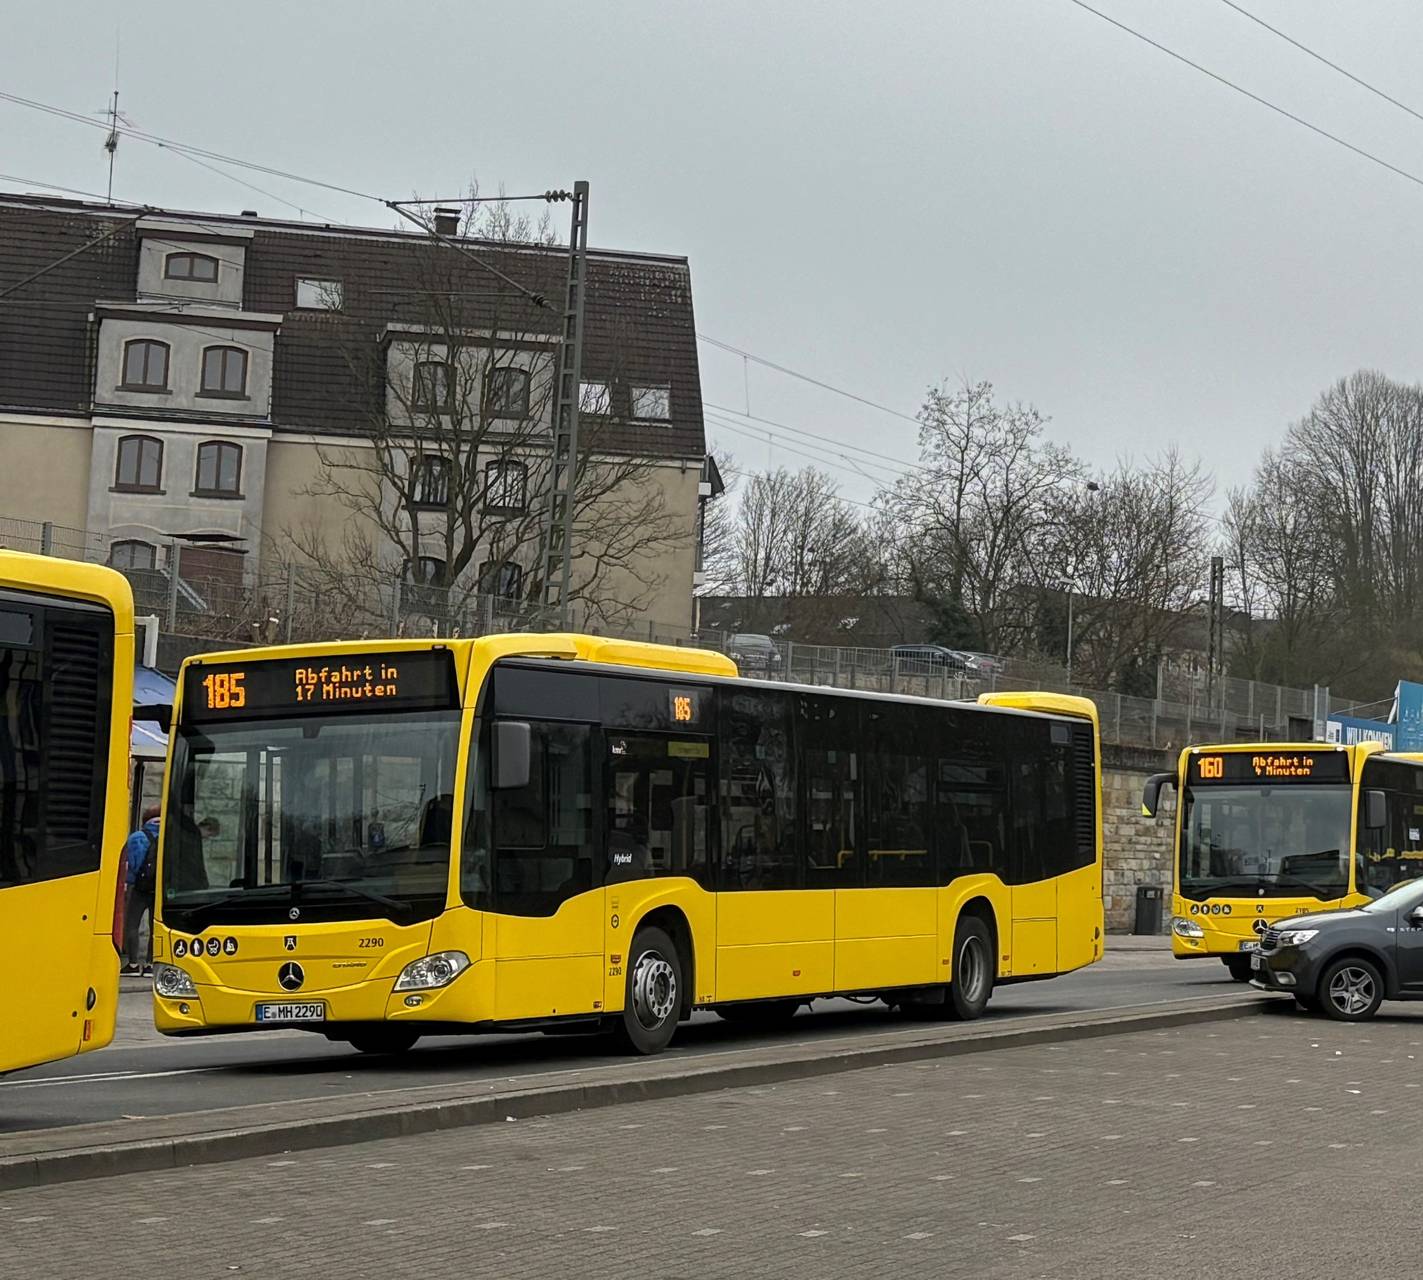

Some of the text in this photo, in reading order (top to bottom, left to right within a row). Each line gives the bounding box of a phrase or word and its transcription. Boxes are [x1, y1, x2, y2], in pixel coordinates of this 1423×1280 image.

[295, 663, 397, 684] Abfahrt in
[203, 672, 245, 709] 185
[295, 684, 397, 701] 17 Minuten
[674, 696, 691, 721] 185
[1198, 757, 1223, 778] 160
[1252, 756, 1313, 767] Abfahrt in
[1255, 766, 1310, 776] 4 Minuten
[613, 853, 633, 866] Hybrid
[358, 938, 384, 948] 2290
[263, 1007, 271, 1019] E
